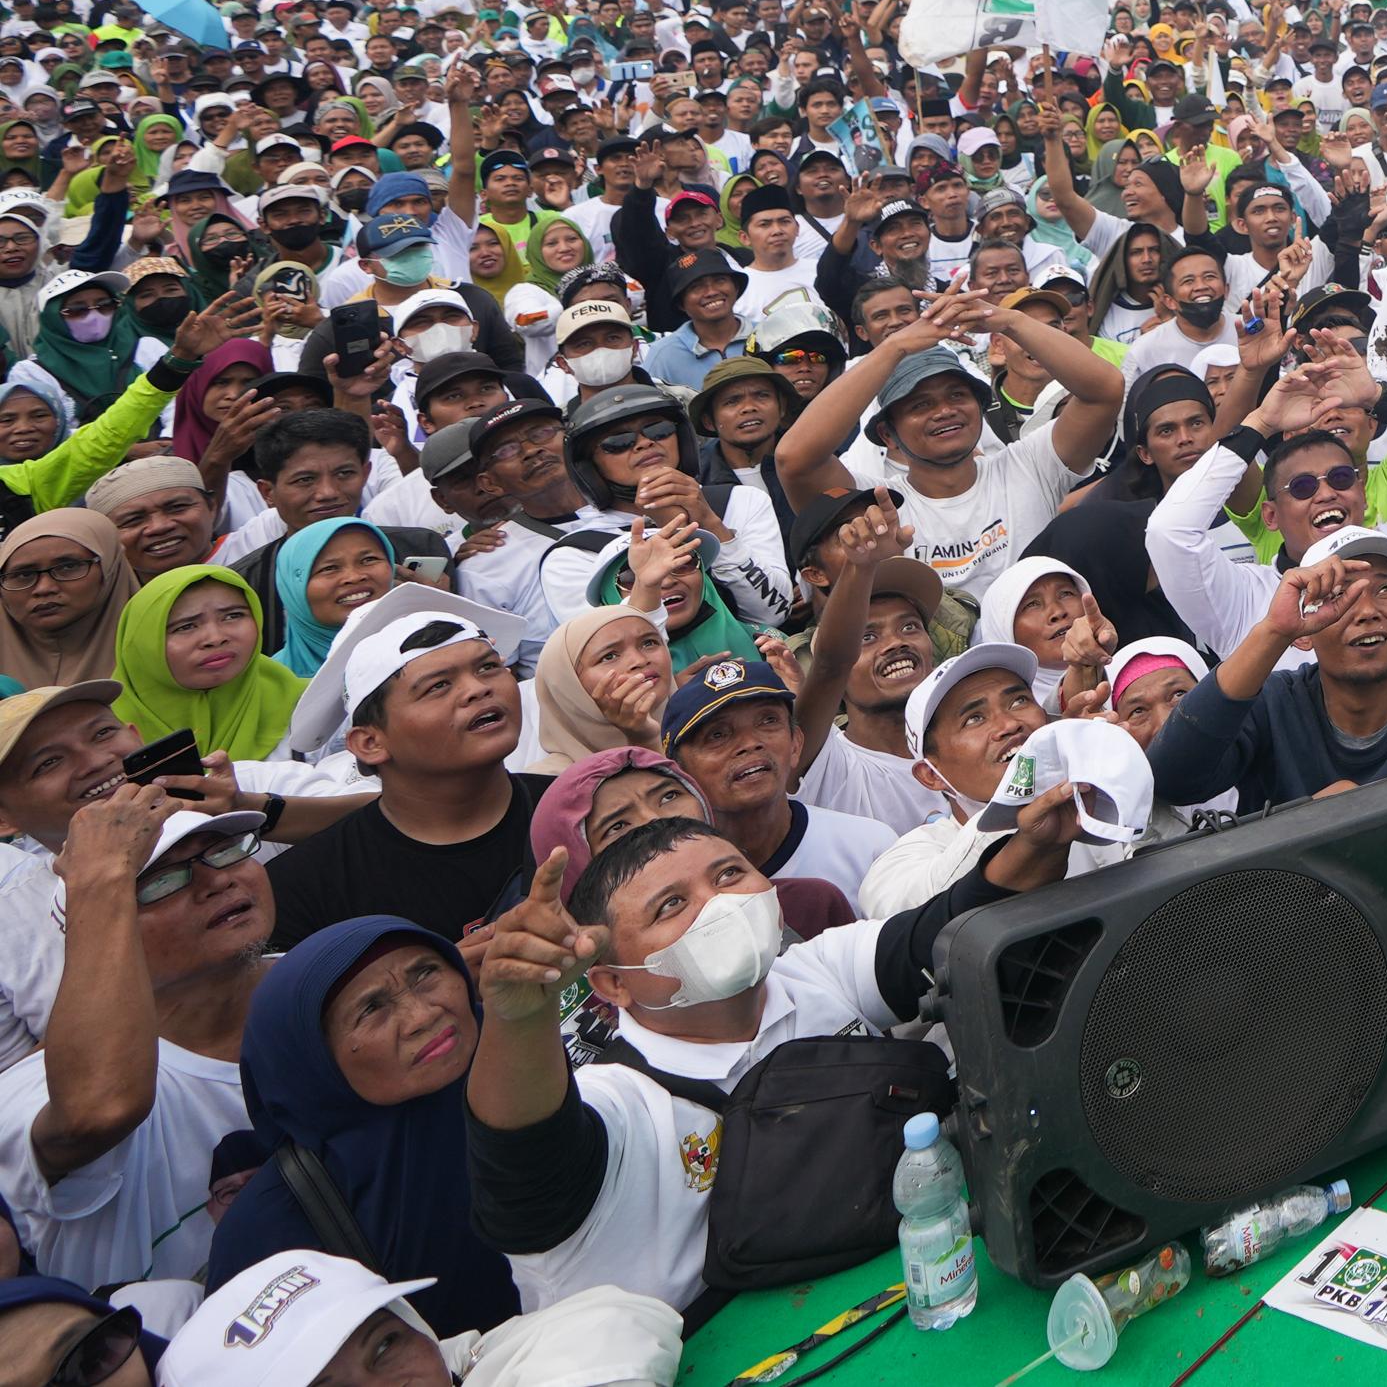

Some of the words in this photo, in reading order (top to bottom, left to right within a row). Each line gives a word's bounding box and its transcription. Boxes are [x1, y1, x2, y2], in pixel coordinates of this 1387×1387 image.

[572, 304, 612, 320] FENDI
[1006, 784, 1034, 796] PKB
[955, 1254, 968, 1268] Le
[1296, 1248, 1346, 1290] 1
[1317, 1284, 1360, 1309] PKB
